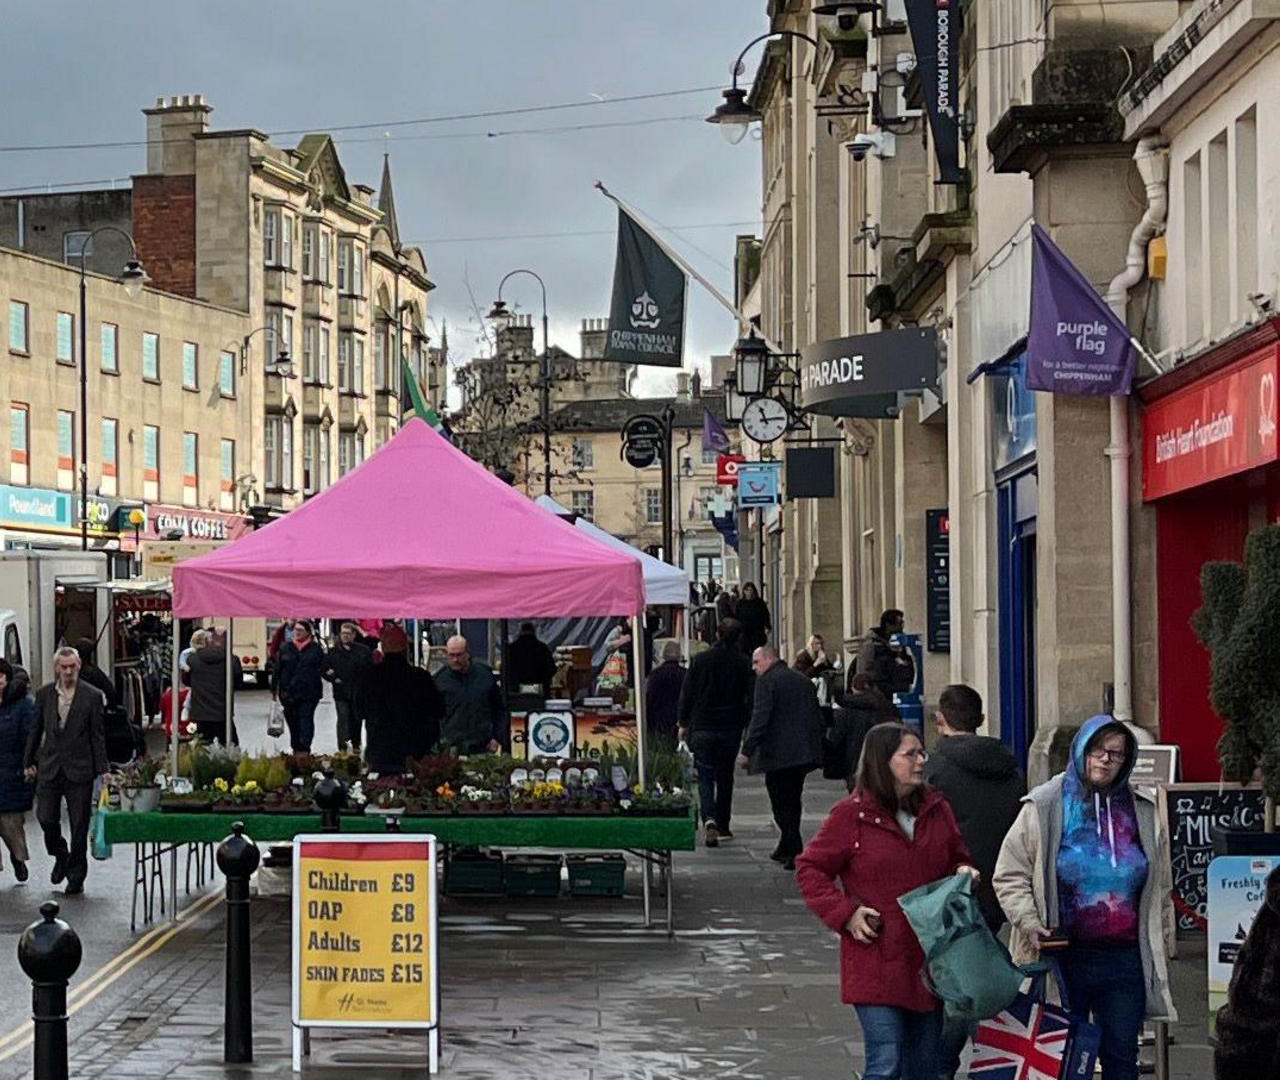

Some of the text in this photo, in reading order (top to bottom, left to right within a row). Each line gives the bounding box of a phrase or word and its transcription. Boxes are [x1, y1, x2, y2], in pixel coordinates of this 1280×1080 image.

[937, 10, 949, 113] BOROUGH PARADE
[1056, 321, 1108, 336] purple
[1075, 334, 1106, 355] flag
[809, 355, 864, 390] PARADE
[8, 494, 57, 518] Poundland
[191, 516, 228, 539] COFFEE
[308, 871, 415, 893] Children £9
[308, 900, 416, 923] OAP £8
[308, 931, 424, 953] Adults £12
[306, 964, 423, 983] SKIN FADES £15
